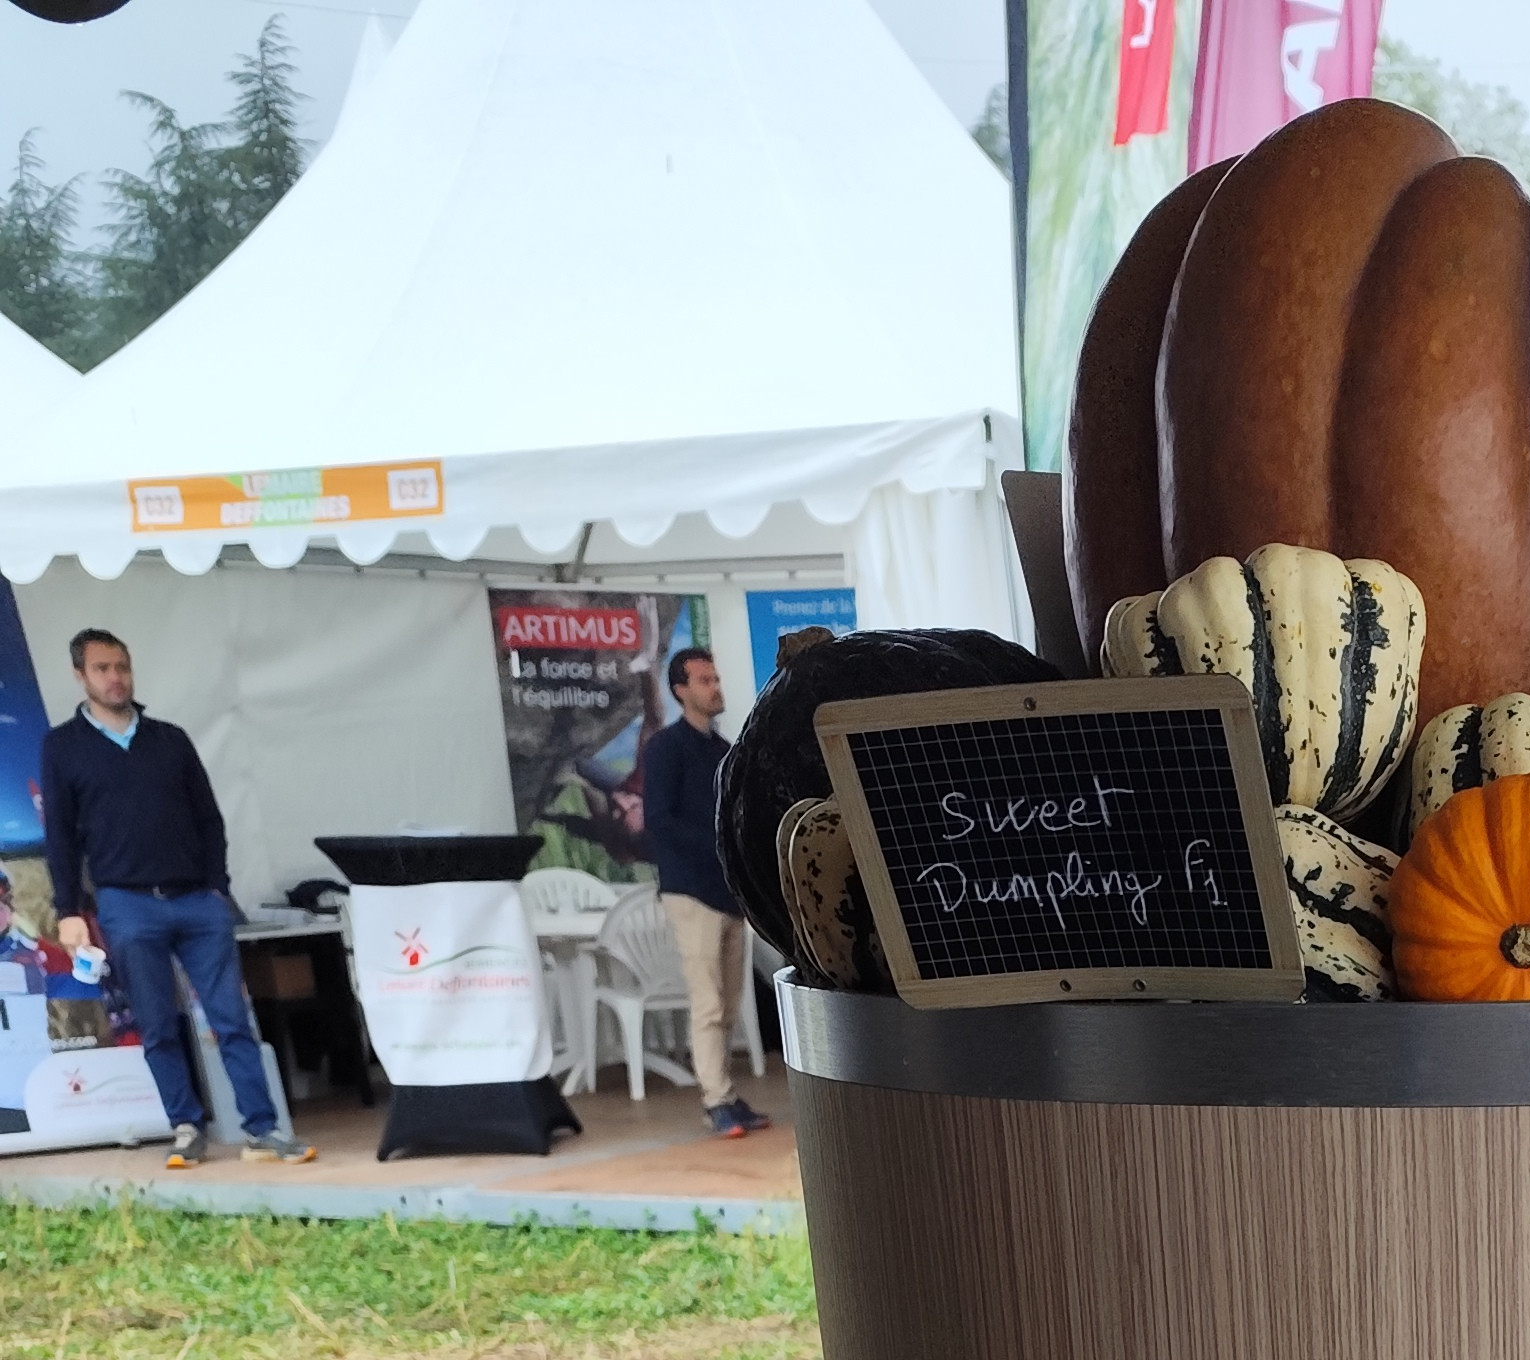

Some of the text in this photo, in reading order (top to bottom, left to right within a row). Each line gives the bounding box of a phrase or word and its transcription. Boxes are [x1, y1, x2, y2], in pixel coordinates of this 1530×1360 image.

[504, 614, 637, 645] ARTIMUS
[540, 656, 593, 680] force
[942, 776, 1135, 840] Sweet
[917, 852, 1163, 930] Dumpling
